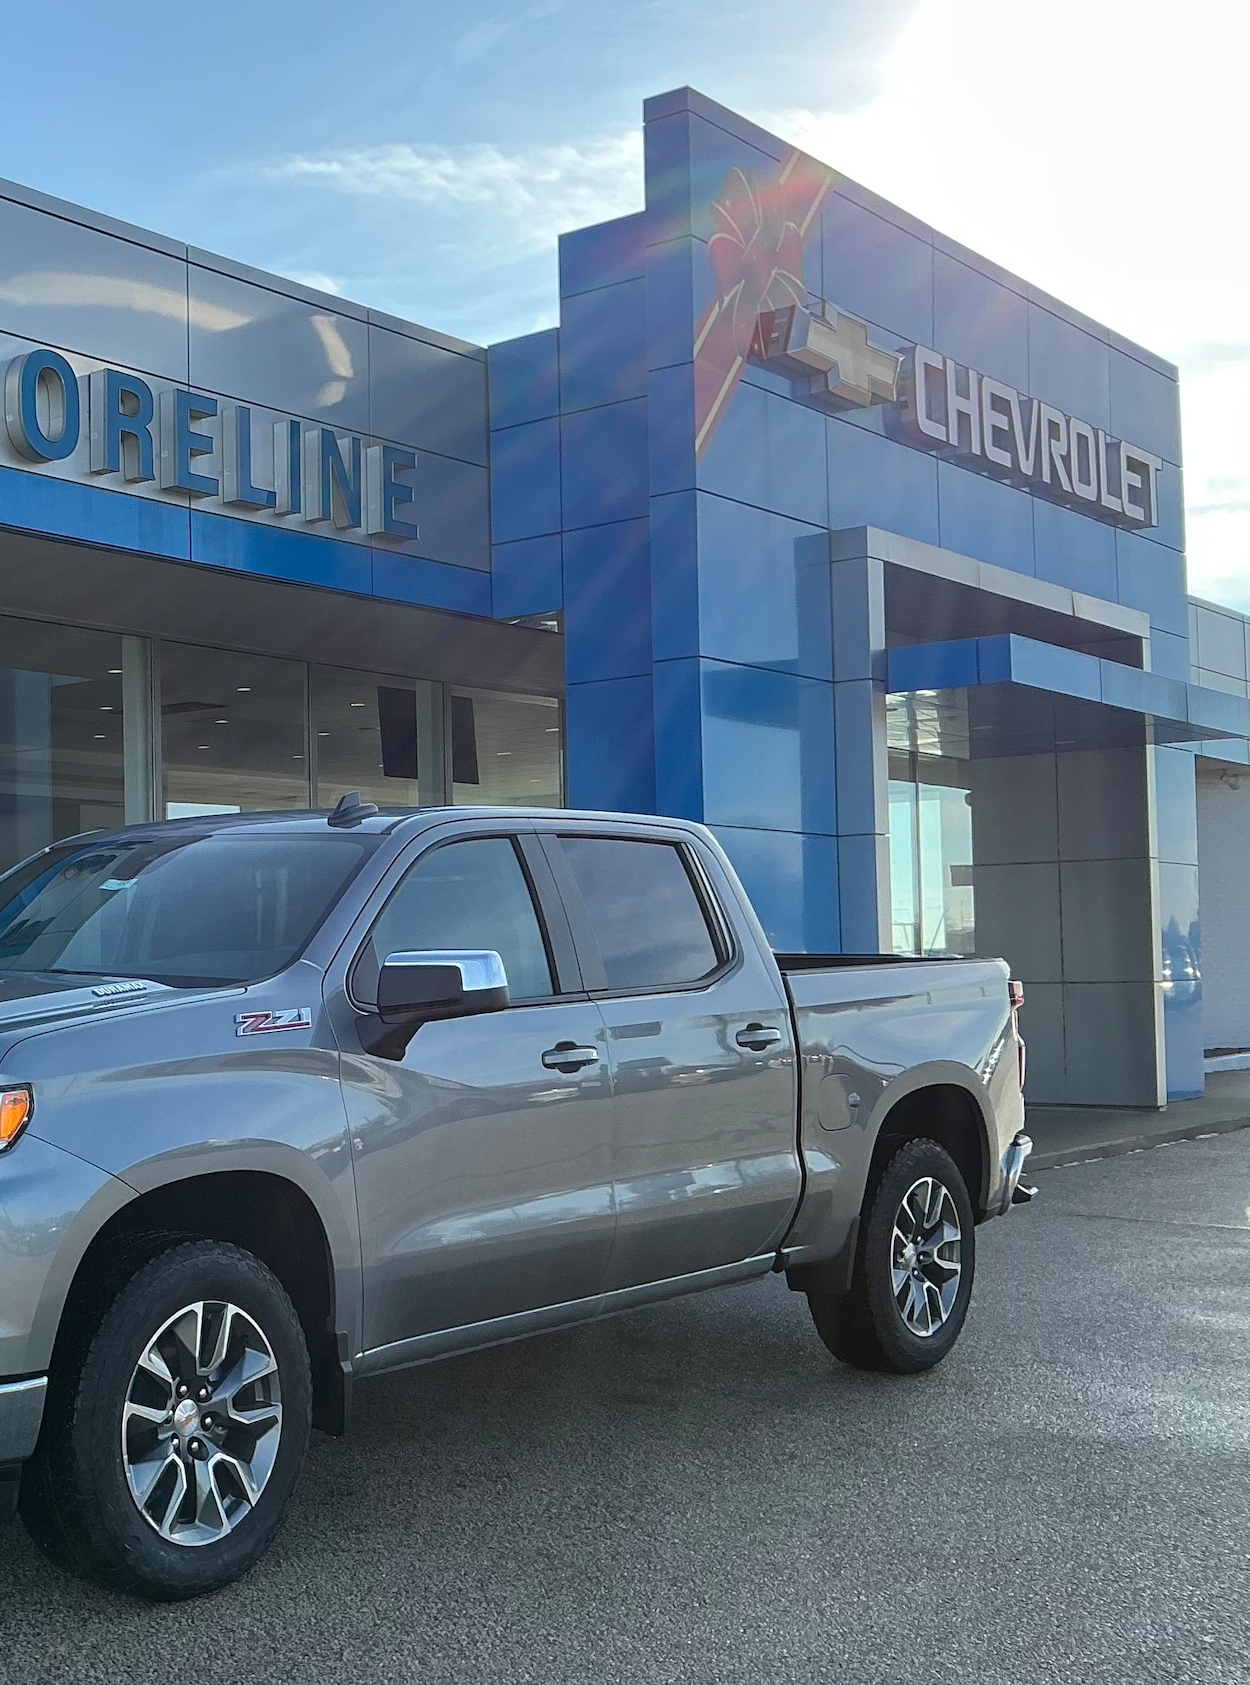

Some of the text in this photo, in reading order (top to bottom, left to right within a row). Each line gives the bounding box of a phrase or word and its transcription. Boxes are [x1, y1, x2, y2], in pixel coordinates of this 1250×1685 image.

[910, 343, 1163, 529] CHEVROLET
[92, 980, 147, 997] DURAMAX
[235, 1007, 312, 1036] Z71
